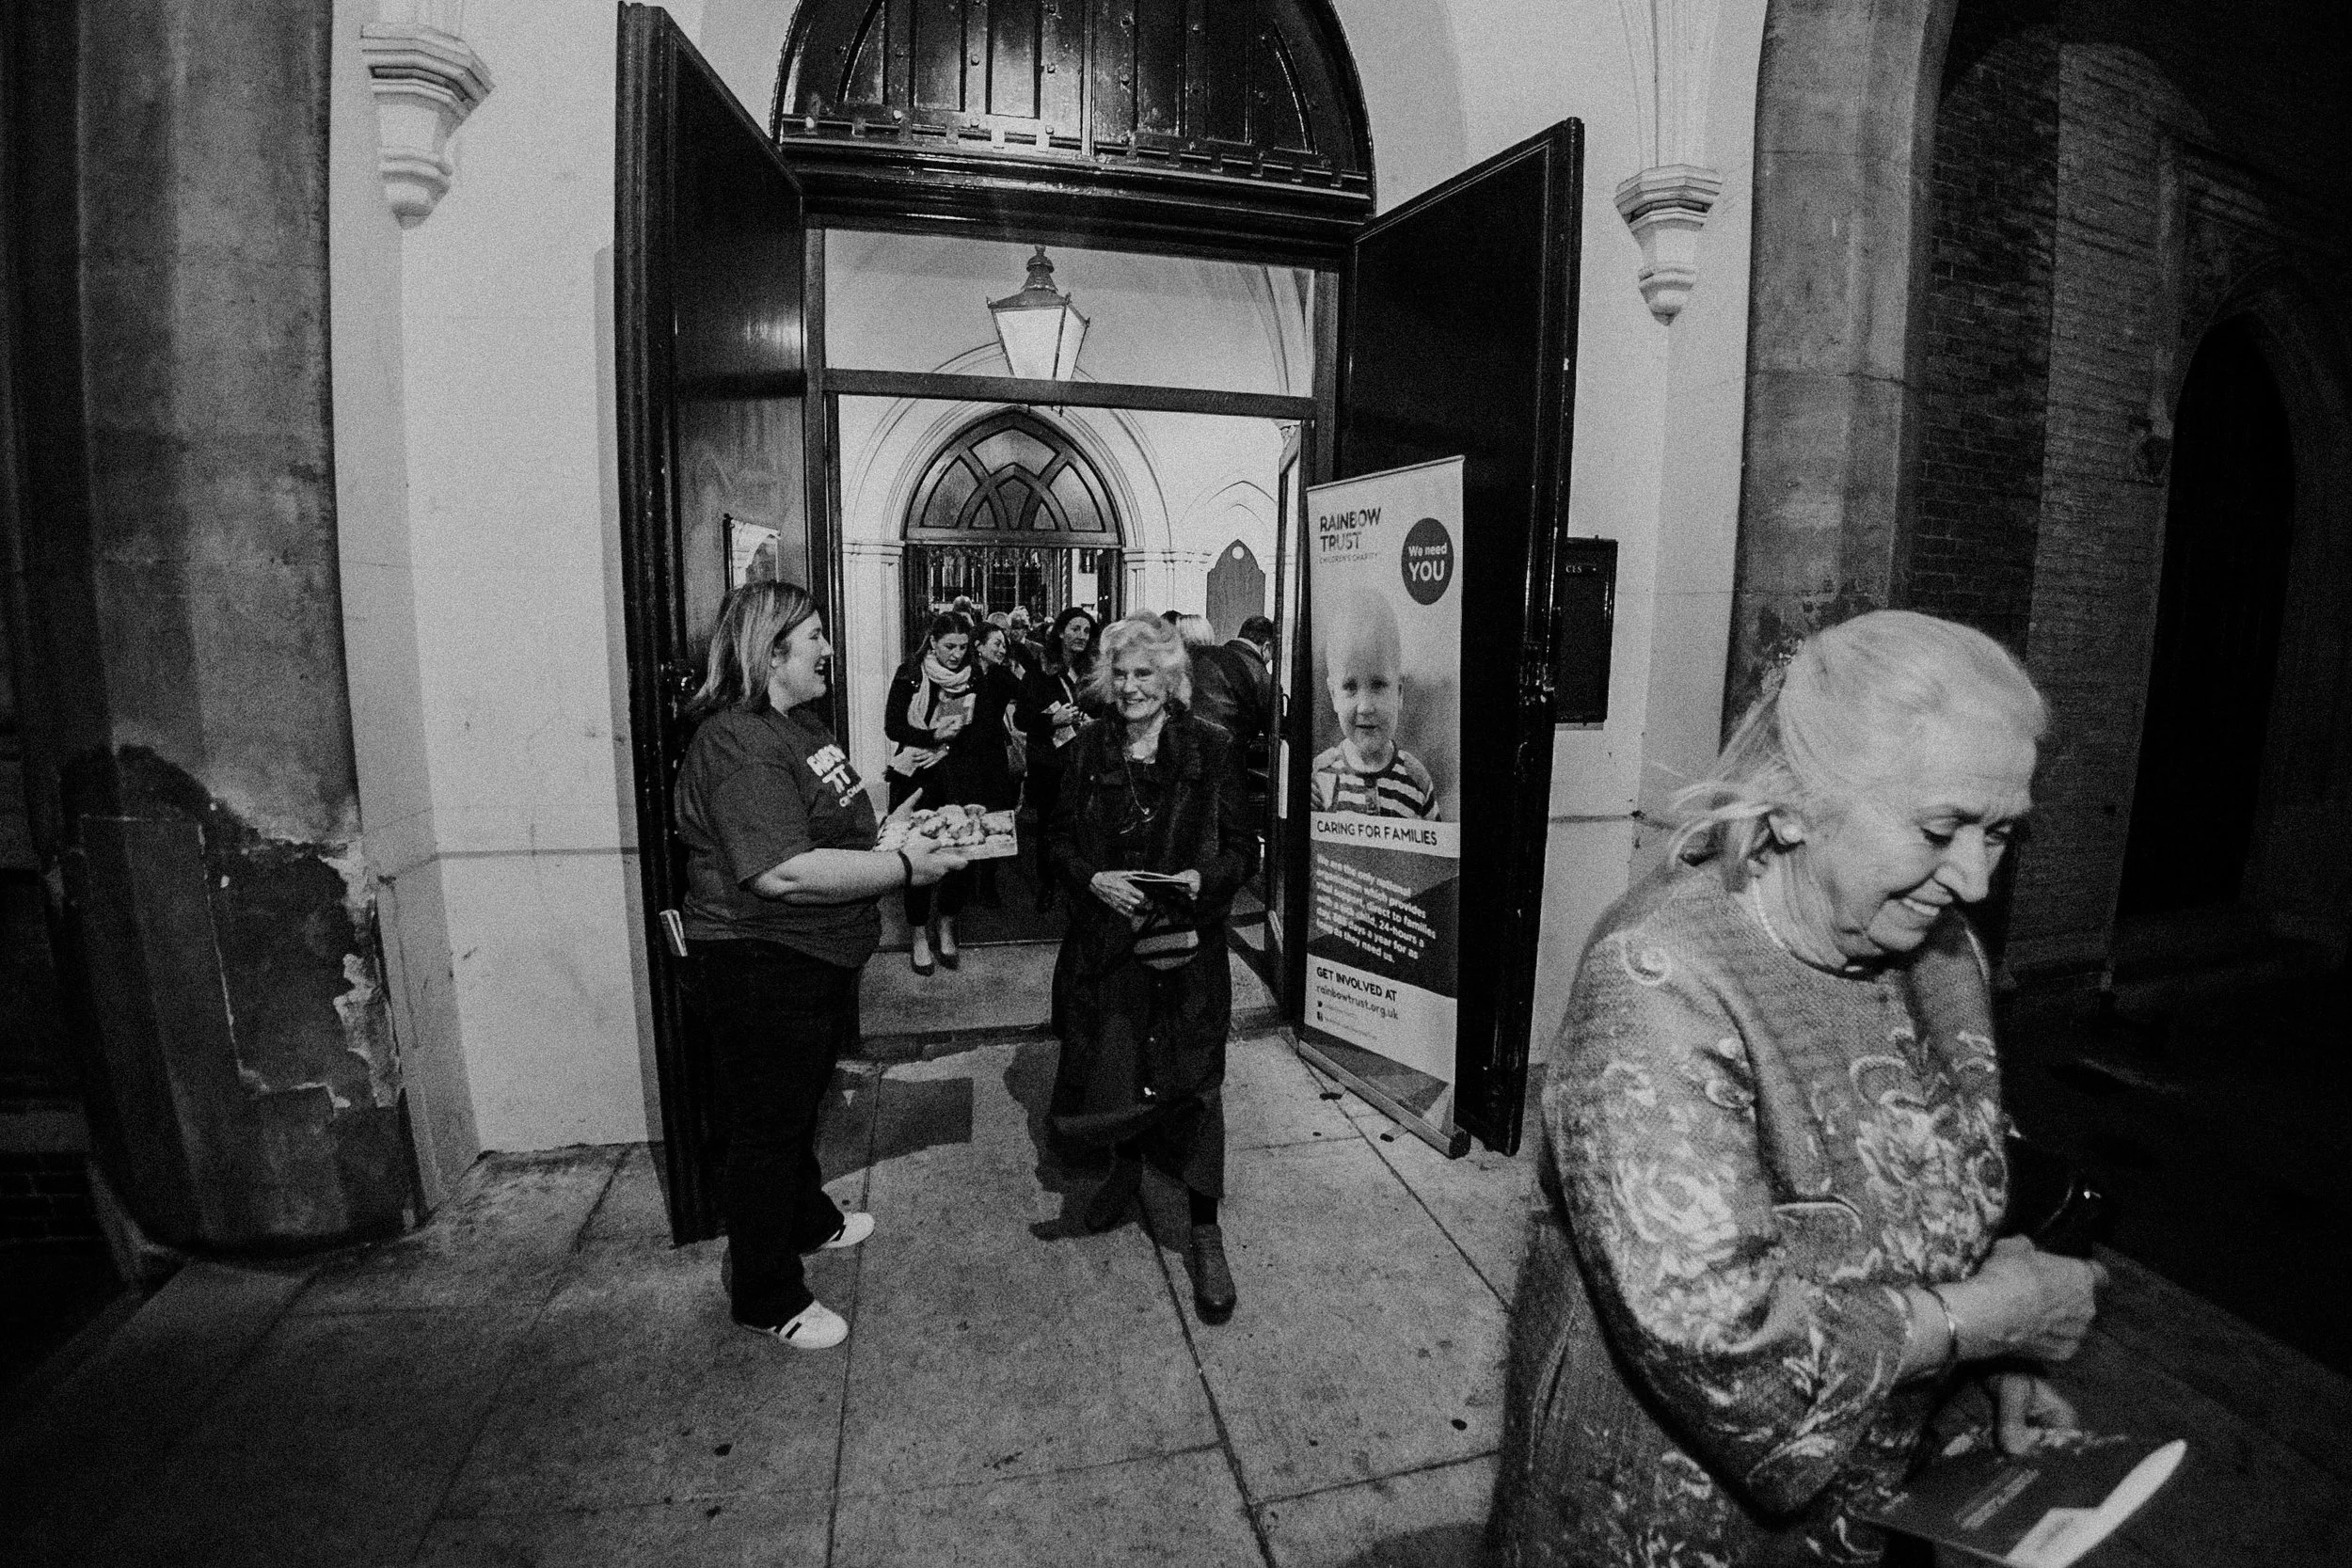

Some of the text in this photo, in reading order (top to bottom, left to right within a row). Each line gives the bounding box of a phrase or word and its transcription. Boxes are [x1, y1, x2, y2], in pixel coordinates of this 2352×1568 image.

[1320, 506, 1381, 532] RAINBOW
[1320, 531, 1362, 552] TRUST
[1408, 542, 1447, 557] We need
[1408, 560, 1445, 582] YOU
[1317, 820, 1438, 846] CARING FOR FAMILIES
[1358, 871, 1375, 885] only
[1367, 901, 1391, 918] direct
[1392, 911, 1402, 923] to
[1404, 915, 1436, 940] families
[1389, 897, 1426, 919] provides
[1333, 927, 1343, 939] as
[1343, 931, 1360, 947] they
[1361, 942, 1382, 957] need
[1348, 921, 1366, 936] days
[1367, 930, 1373, 939] a
[1374, 933, 1392, 947] year
[1393, 940, 1406, 954] for
[1407, 948, 1419, 959] as
[1378, 920, 1417, 944] 24-hours
[1419, 939, 1424, 948] a
[1316, 966, 1398, 1002] GET INVOLVED AT
[1316, 984, 1399, 1020] rainbowtrust.org.uk
